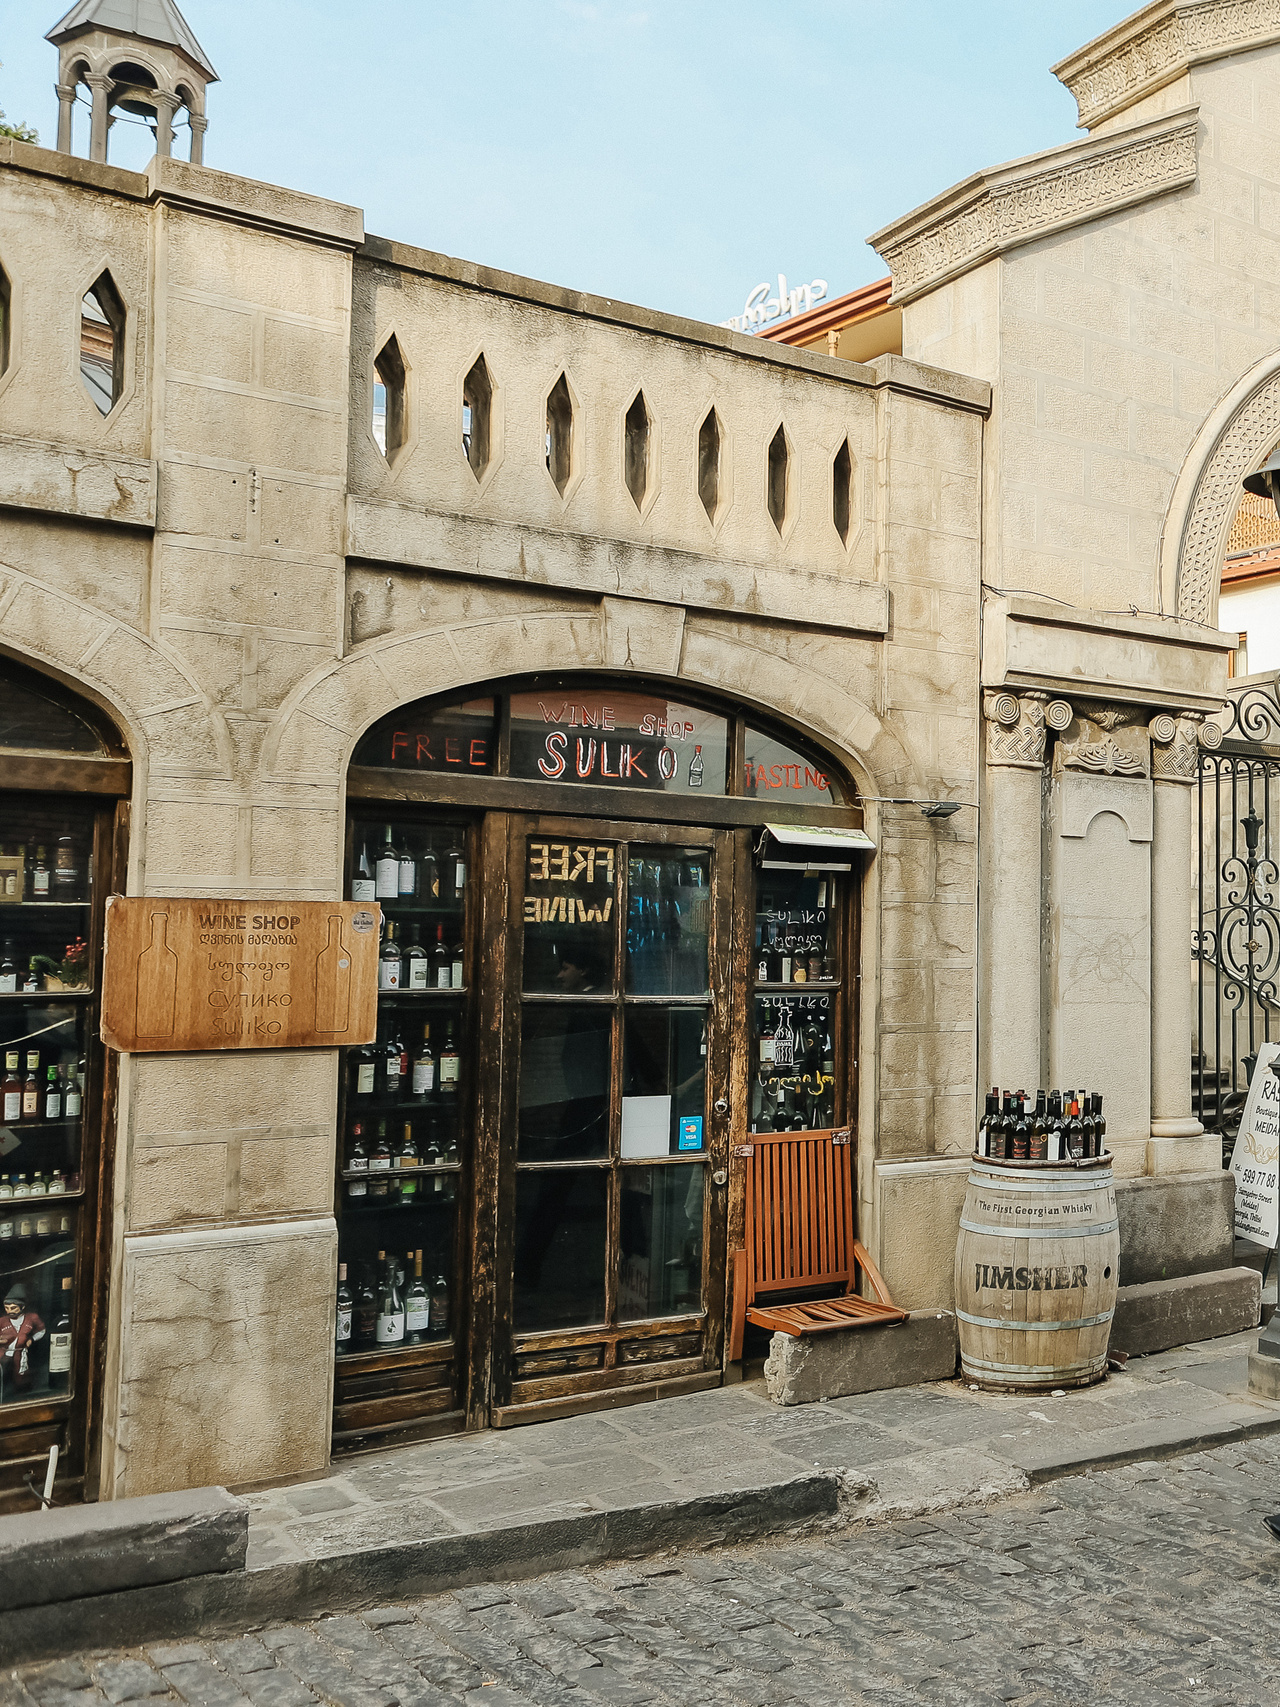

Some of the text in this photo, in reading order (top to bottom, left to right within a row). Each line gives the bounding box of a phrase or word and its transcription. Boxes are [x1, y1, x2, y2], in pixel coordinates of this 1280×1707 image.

[537, 701, 695, 741] WINE SHOP
[391, 731, 487, 766] FREE
[744, 763, 831, 791] TASTING
[199, 915, 300, 930] WINE SHOP
[199, 933, 298, 945] ღვინის მაღაზია
[207, 990, 293, 1013] Сулико
[211, 1015, 282, 1036] Suliko
[1255, 1105, 1278, 1120] Boutique
[1255, 1120, 1280, 1136] MEIDA
[1242, 1168, 1277, 1189] 599 77 88
[979, 1200, 1093, 1218] The First Georgian Whisky
[975, 1263, 1088, 1293] JIMSHER
